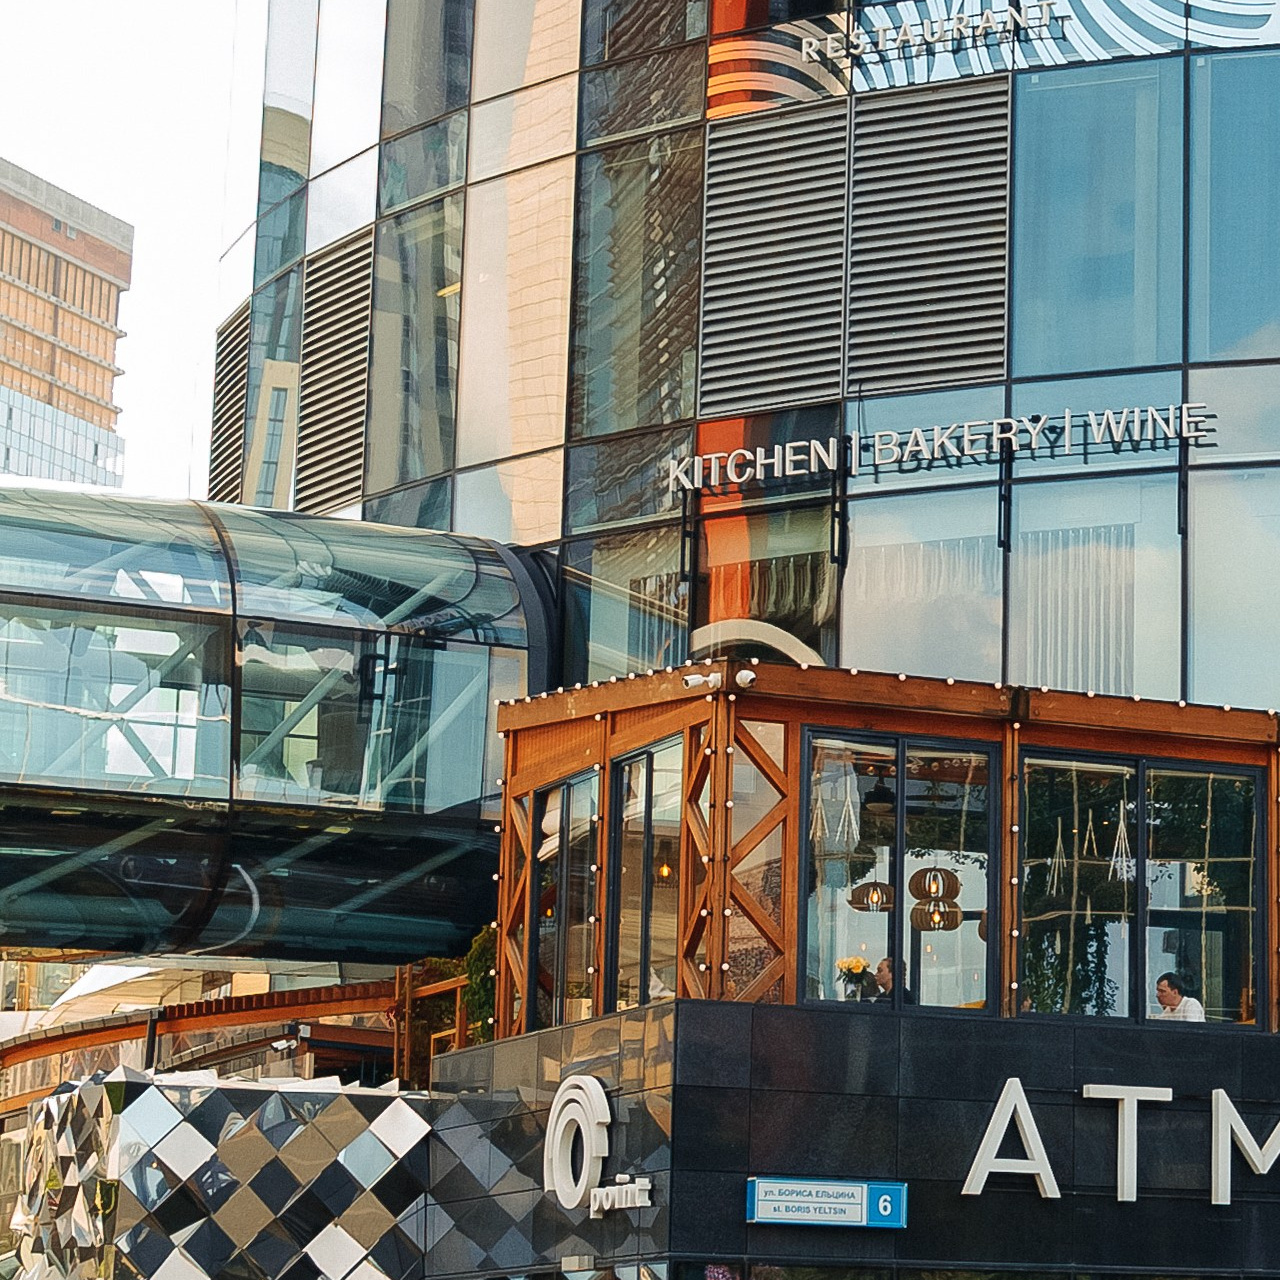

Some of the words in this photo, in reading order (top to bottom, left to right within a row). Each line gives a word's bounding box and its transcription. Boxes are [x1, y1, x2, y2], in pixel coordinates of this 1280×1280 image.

[801, 0, 1058, 63] RESTAURANT
[668, 436, 838, 492] KITCHEN
[874, 413, 1050, 466] BAKERY
[1087, 401, 1210, 444] WINE
[778, 1189, 813, 1198] БОРИСА
[815, 1190, 856, 1200] ЕЛЬЦИНА
[878, 1194, 892, 1216] 6
[785, 1204, 811, 1214] BORIS
[812, 1206, 847, 1215] YELTSIN
